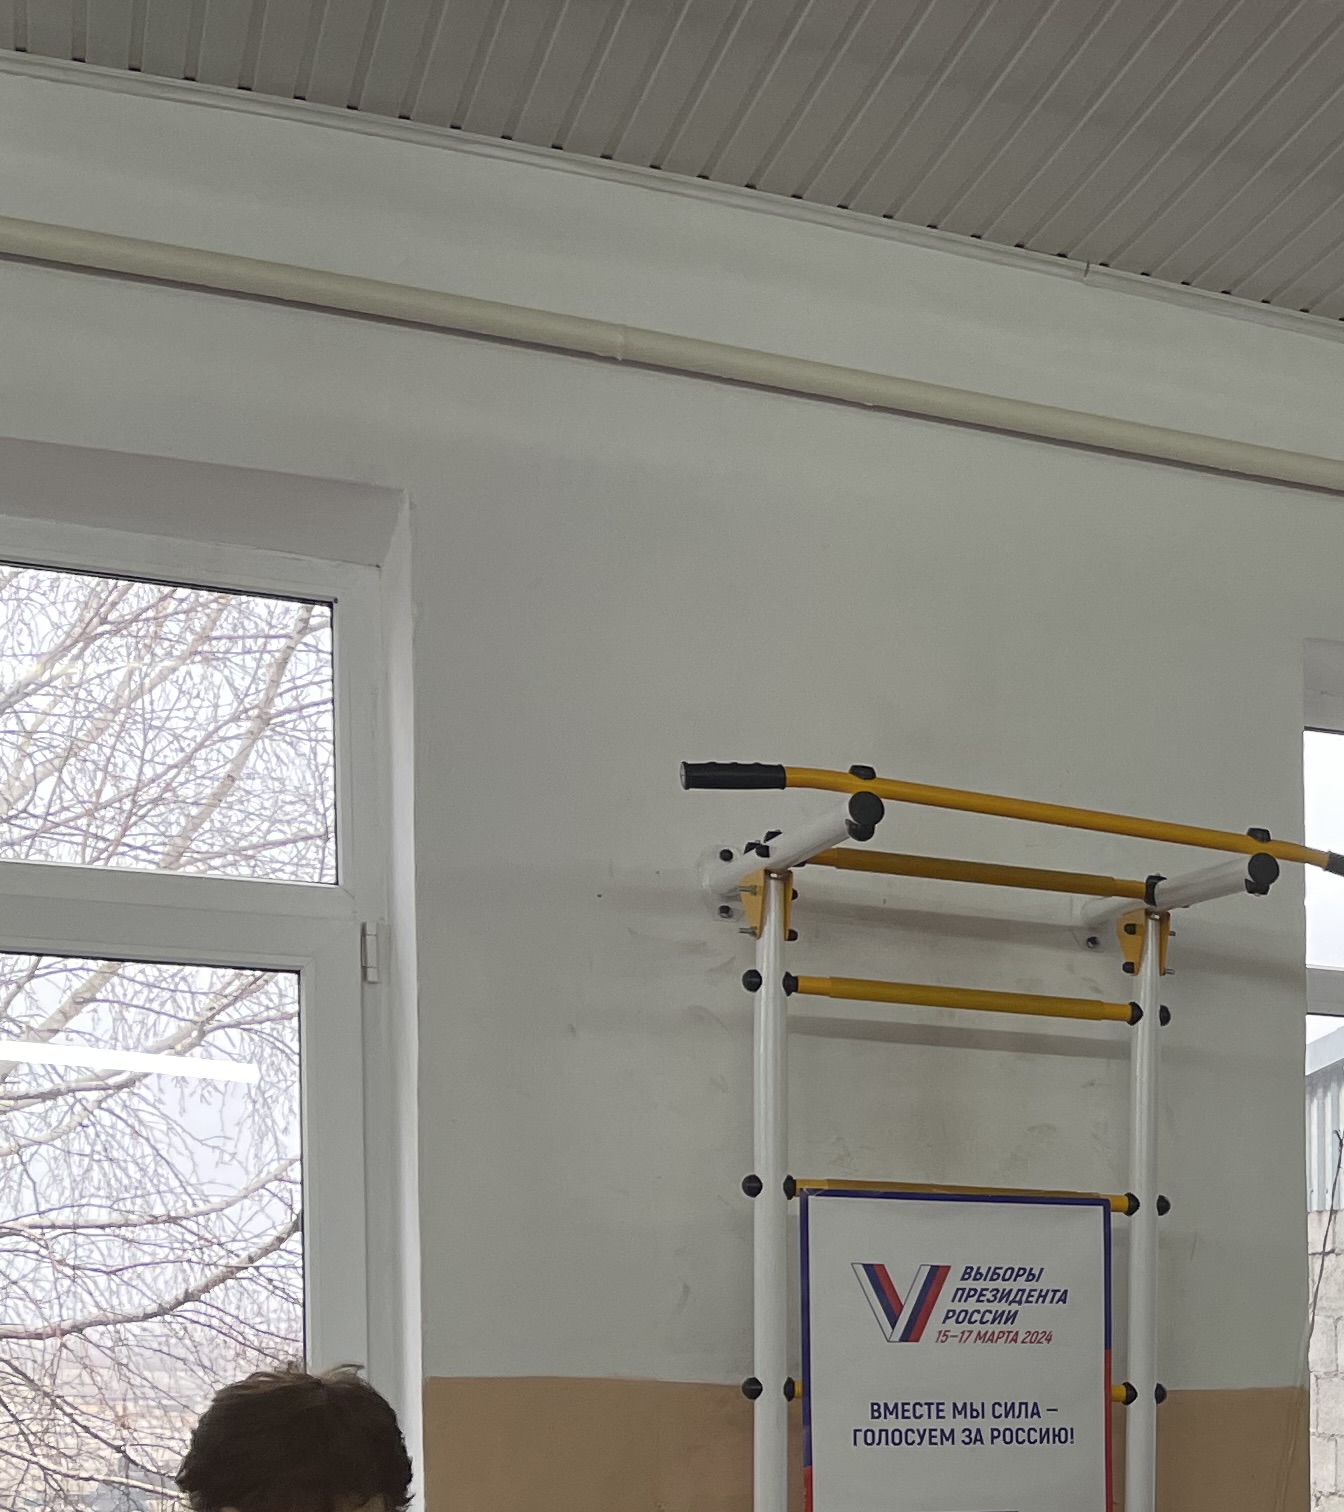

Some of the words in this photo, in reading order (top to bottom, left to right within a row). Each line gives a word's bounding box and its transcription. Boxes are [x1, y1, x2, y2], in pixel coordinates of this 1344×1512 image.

[960, 1265, 1044, 1282] ВЫБОРЫ
[951, 1287, 1068, 1305] ПРЕЗИДЕНТА
[943, 1309, 1018, 1325] РОССИИ
[974, 1330, 1020, 1345] МАРТА
[1021, 1330, 1053, 1345] 2024
[870, 1402, 946, 1420] ВМЕСТЕ
[952, 1402, 985, 1420] МЫ
[991, 1402, 1042, 1421] СИЛА
[852, 1428, 955, 1447] ГОЛОСУЕМ
[961, 1428, 984, 1446] ЗА
[990, 1427, 1075, 1445] РОССИЮ!
